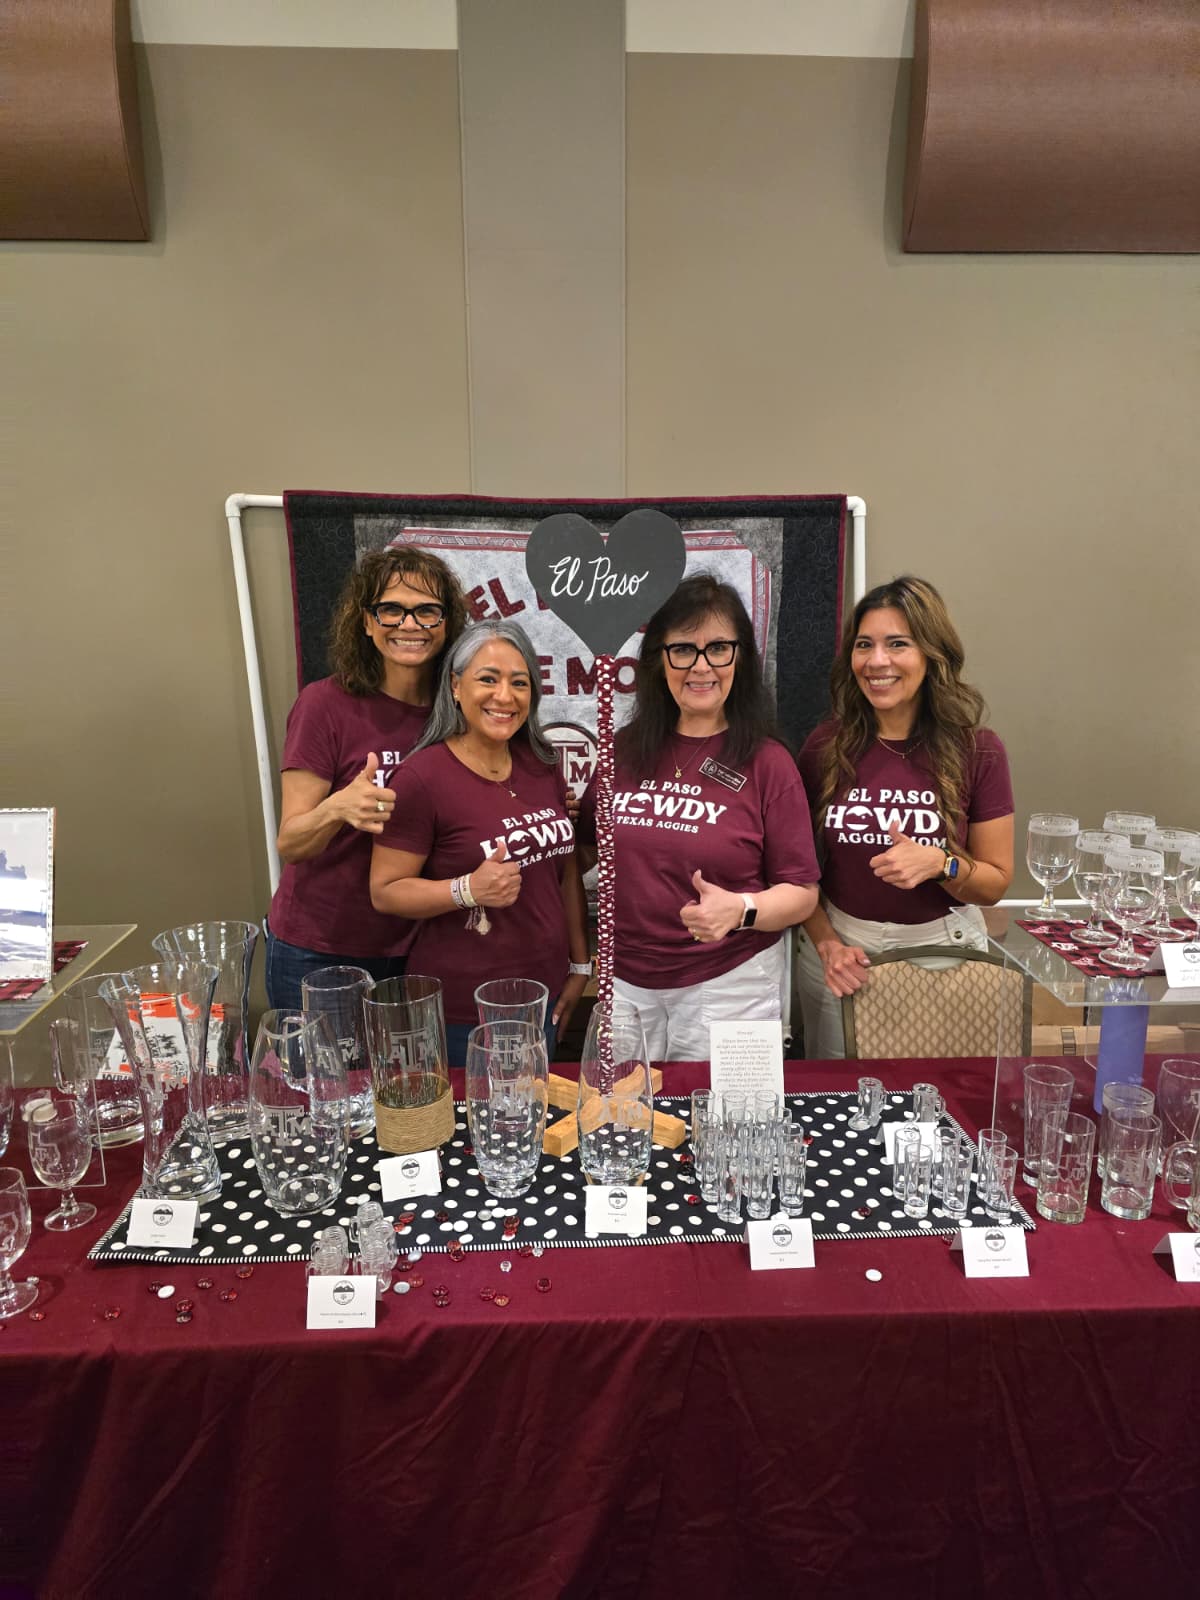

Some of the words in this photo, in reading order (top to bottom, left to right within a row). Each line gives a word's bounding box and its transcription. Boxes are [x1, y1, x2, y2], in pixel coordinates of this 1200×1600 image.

[549, 556, 585, 598] El
[588, 555, 649, 602] Paso
[464, 577, 526, 622] EL
[640, 780, 657, 791] EL
[662, 780, 702, 796] PASO
[847, 788, 872, 802] EL
[879, 789, 936, 805] PASO
[502, 817, 523, 829] EL
[523, 808, 557, 824] PASO
[612, 792, 727, 825] HOWDY
[616, 815, 653, 827] TEXAS
[656, 820, 699, 834] AGGIES
[824, 805, 946, 834] HOWD
[480, 817, 575, 861] HOWD
[838, 832, 893, 846] AGGIE
[516, 852, 543, 869] EXAS
